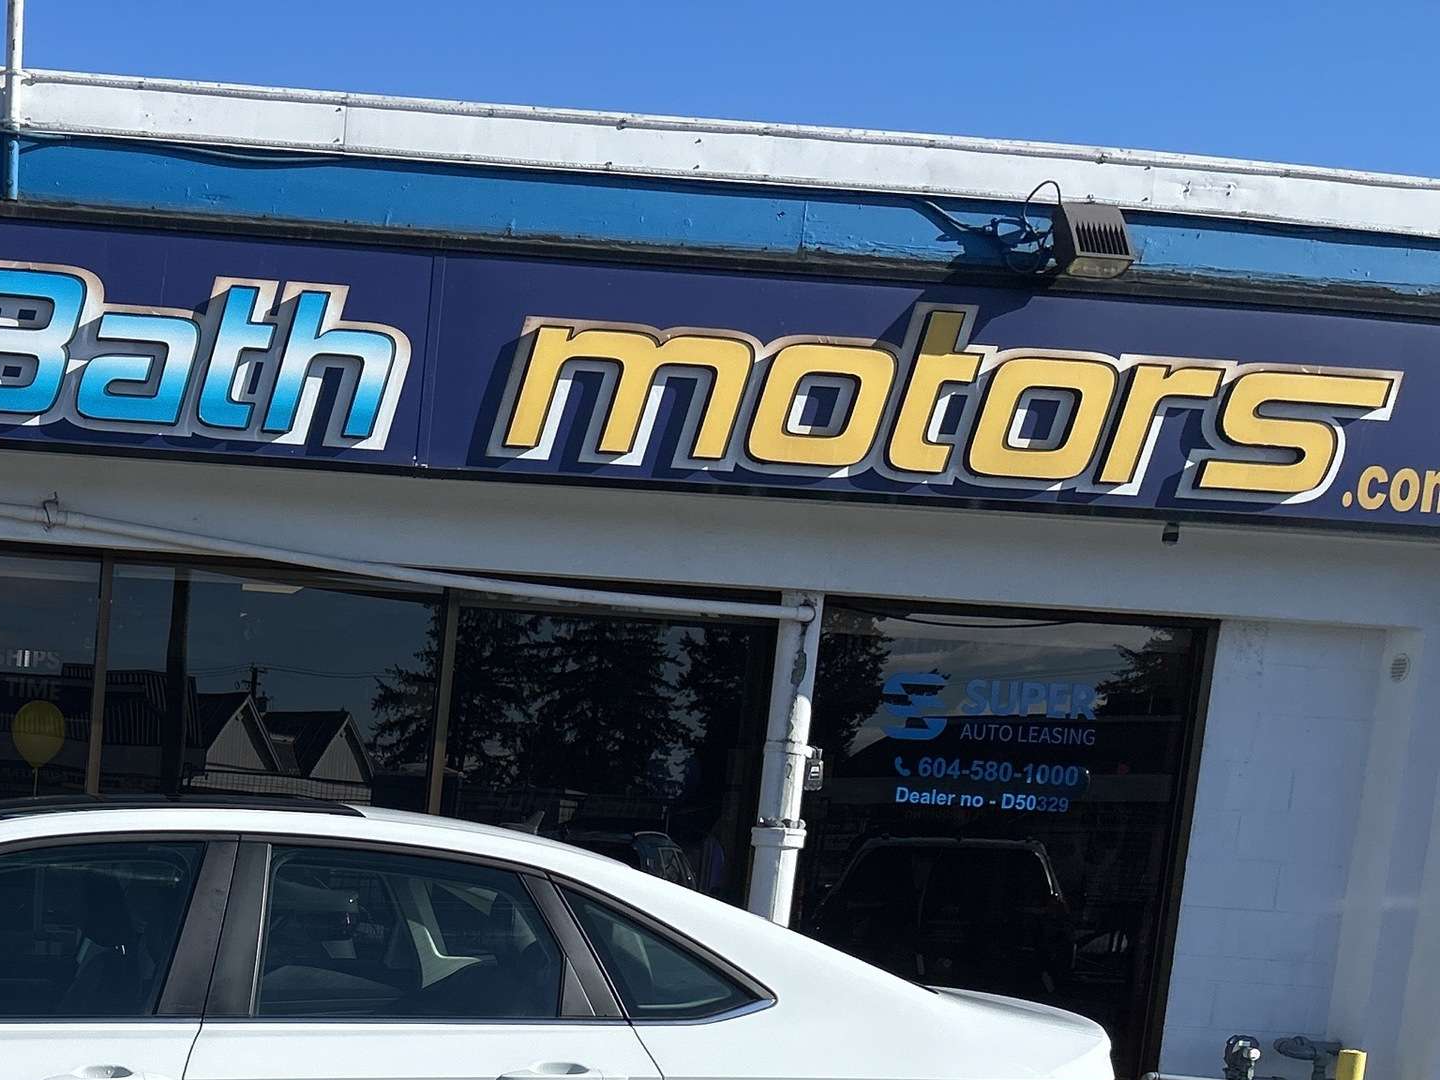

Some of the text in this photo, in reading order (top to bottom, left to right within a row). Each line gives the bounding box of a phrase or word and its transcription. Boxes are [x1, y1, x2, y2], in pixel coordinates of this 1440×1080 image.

[486, 303, 1403, 504] motors
[7, 677, 61, 701] TIME
[961, 679, 1096, 720] SUPER
[960, 723, 1096, 746] AUTO LEASING
[918, 757, 1079, 786] 604-580-1000
[895, 787, 956, 807] Dealer
[960, 794, 984, 808] no
[1001, 793, 1070, 813] D50329
